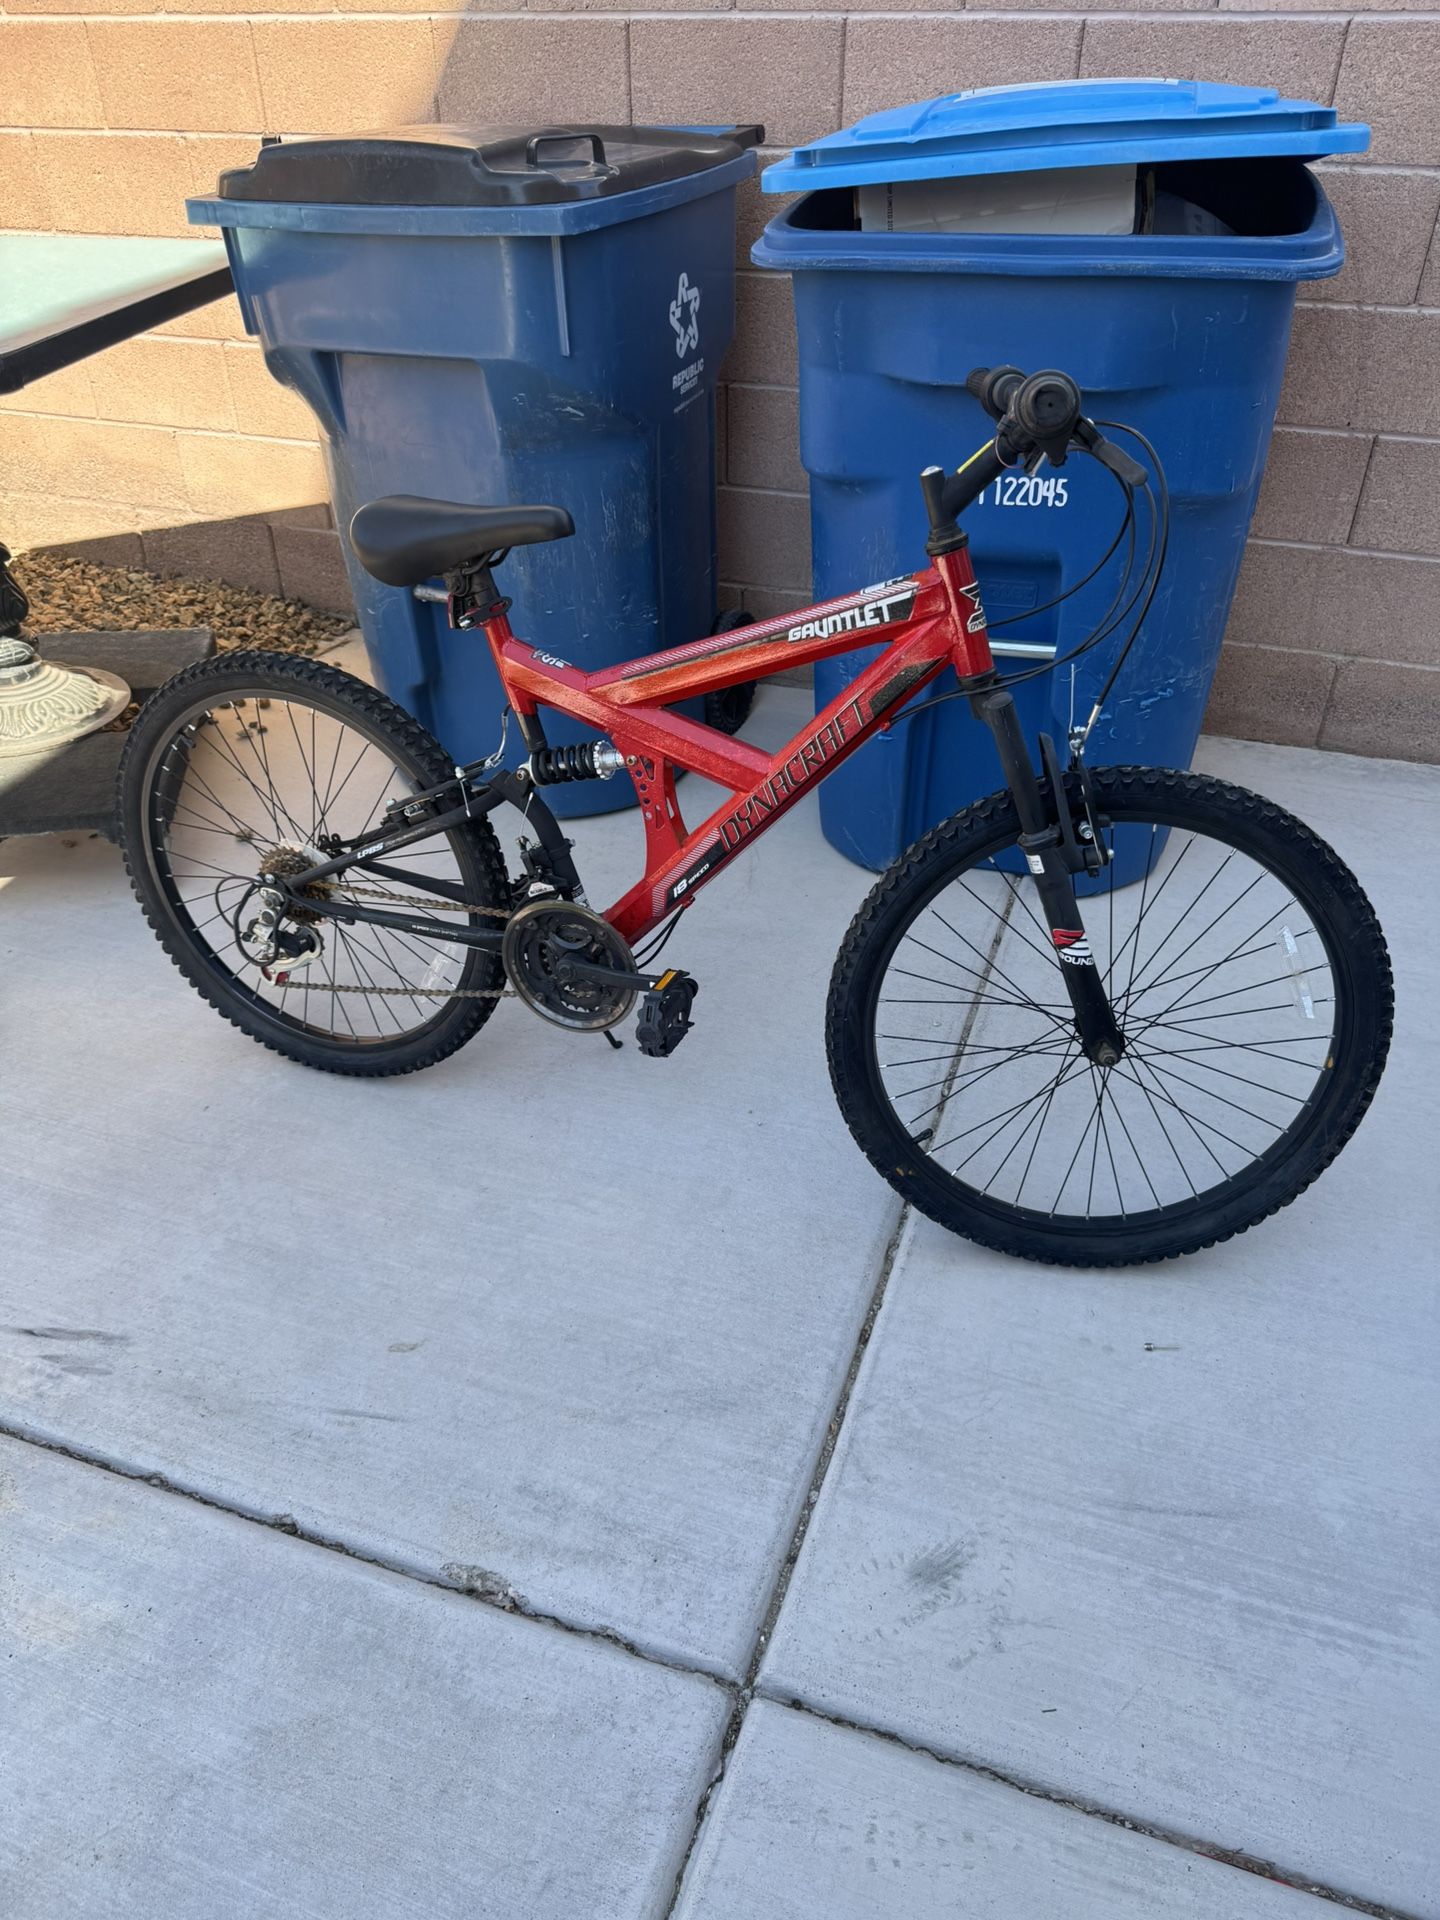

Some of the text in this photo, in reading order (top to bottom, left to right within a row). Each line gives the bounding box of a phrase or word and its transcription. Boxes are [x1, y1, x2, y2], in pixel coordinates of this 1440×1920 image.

[672, 358, 704, 390] REPUBLIC
[994, 476, 1068, 507] 122045
[788, 591, 912, 642] GAUNTLET
[719, 688, 865, 849] DYNACRAFT
[673, 879, 687, 898] 18
